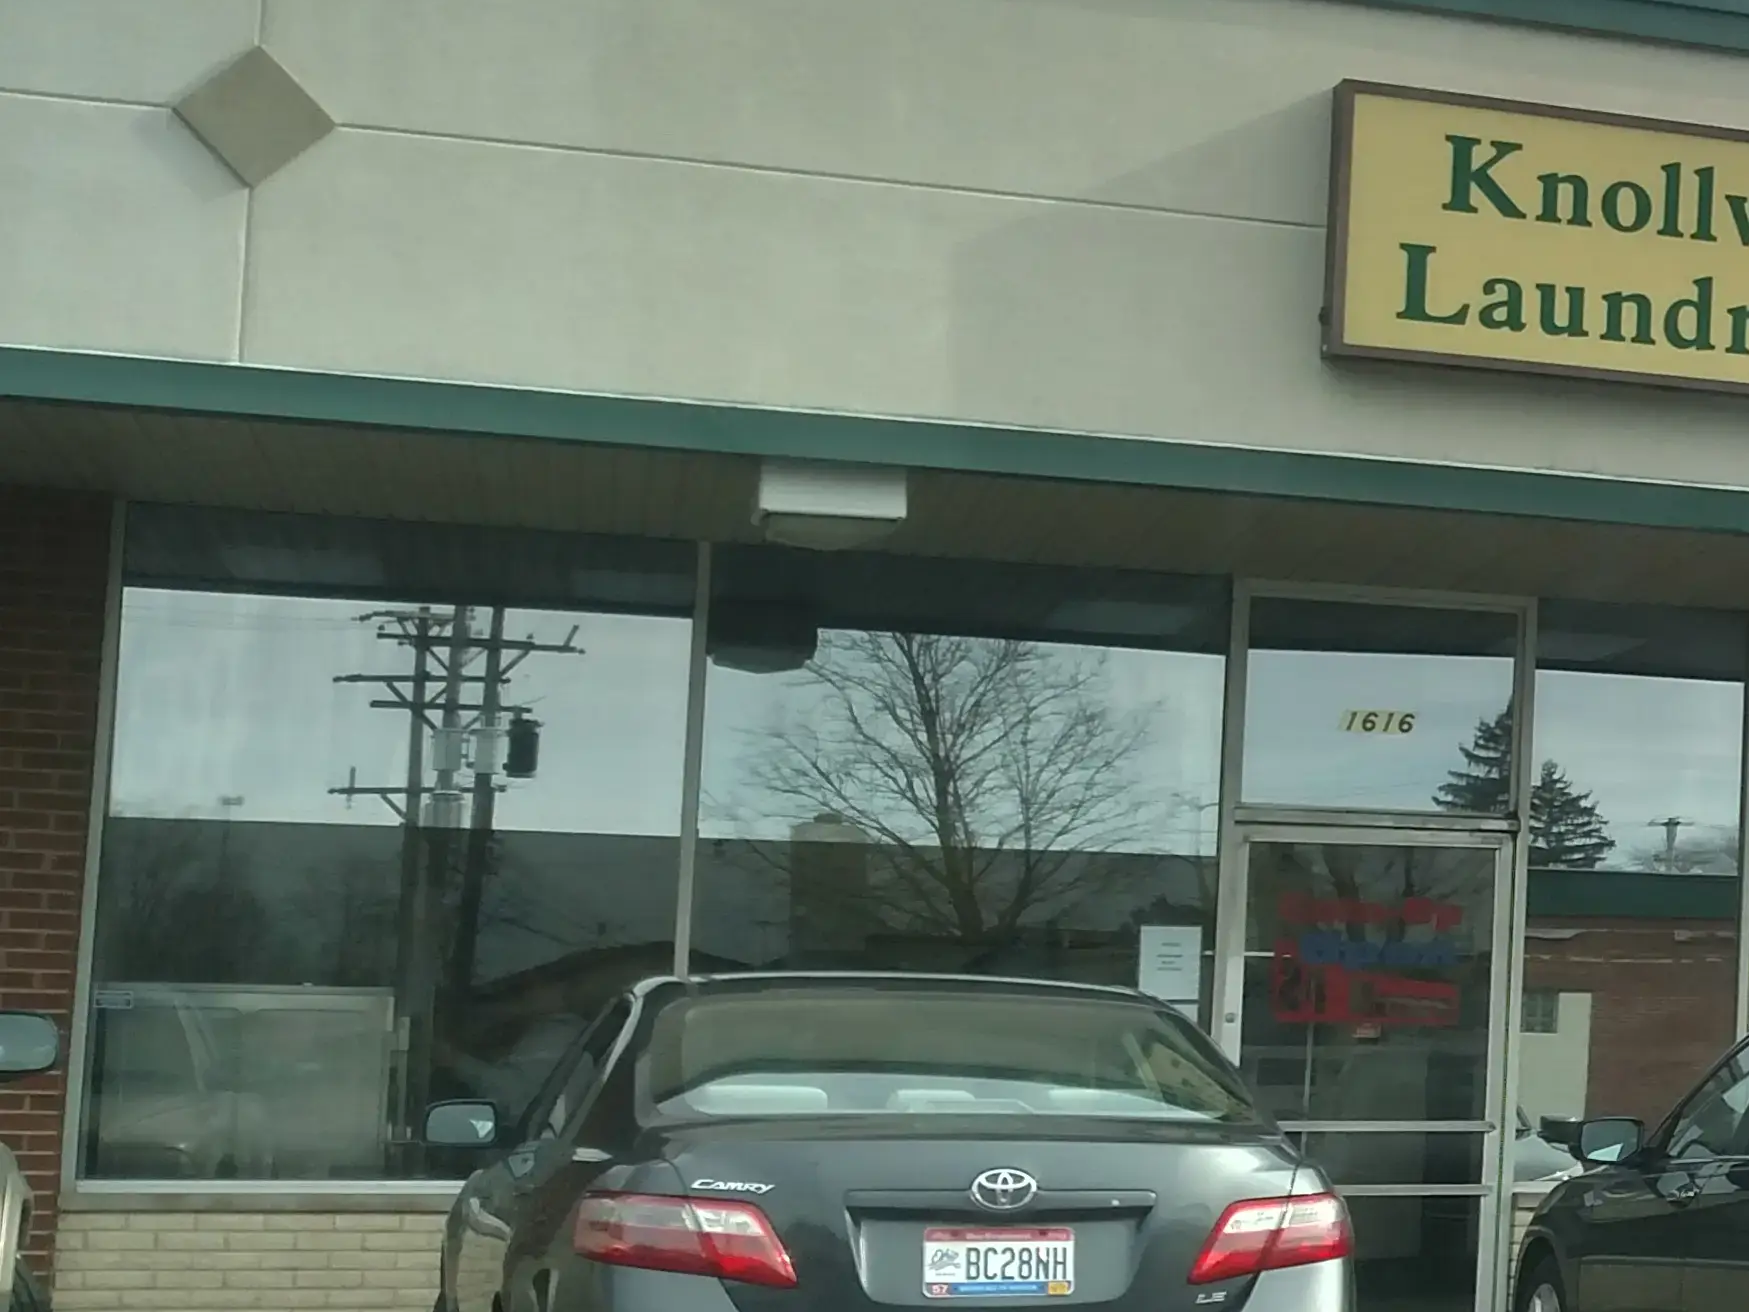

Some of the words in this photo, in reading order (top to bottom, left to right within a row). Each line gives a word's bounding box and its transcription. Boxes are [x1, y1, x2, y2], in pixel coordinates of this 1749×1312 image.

[1345, 710, 1416, 734] 1616
[690, 1178, 776, 1195] CAMRY
[965, 1246, 1068, 1280] BC28NH
[1195, 1290, 1228, 1304] LE
